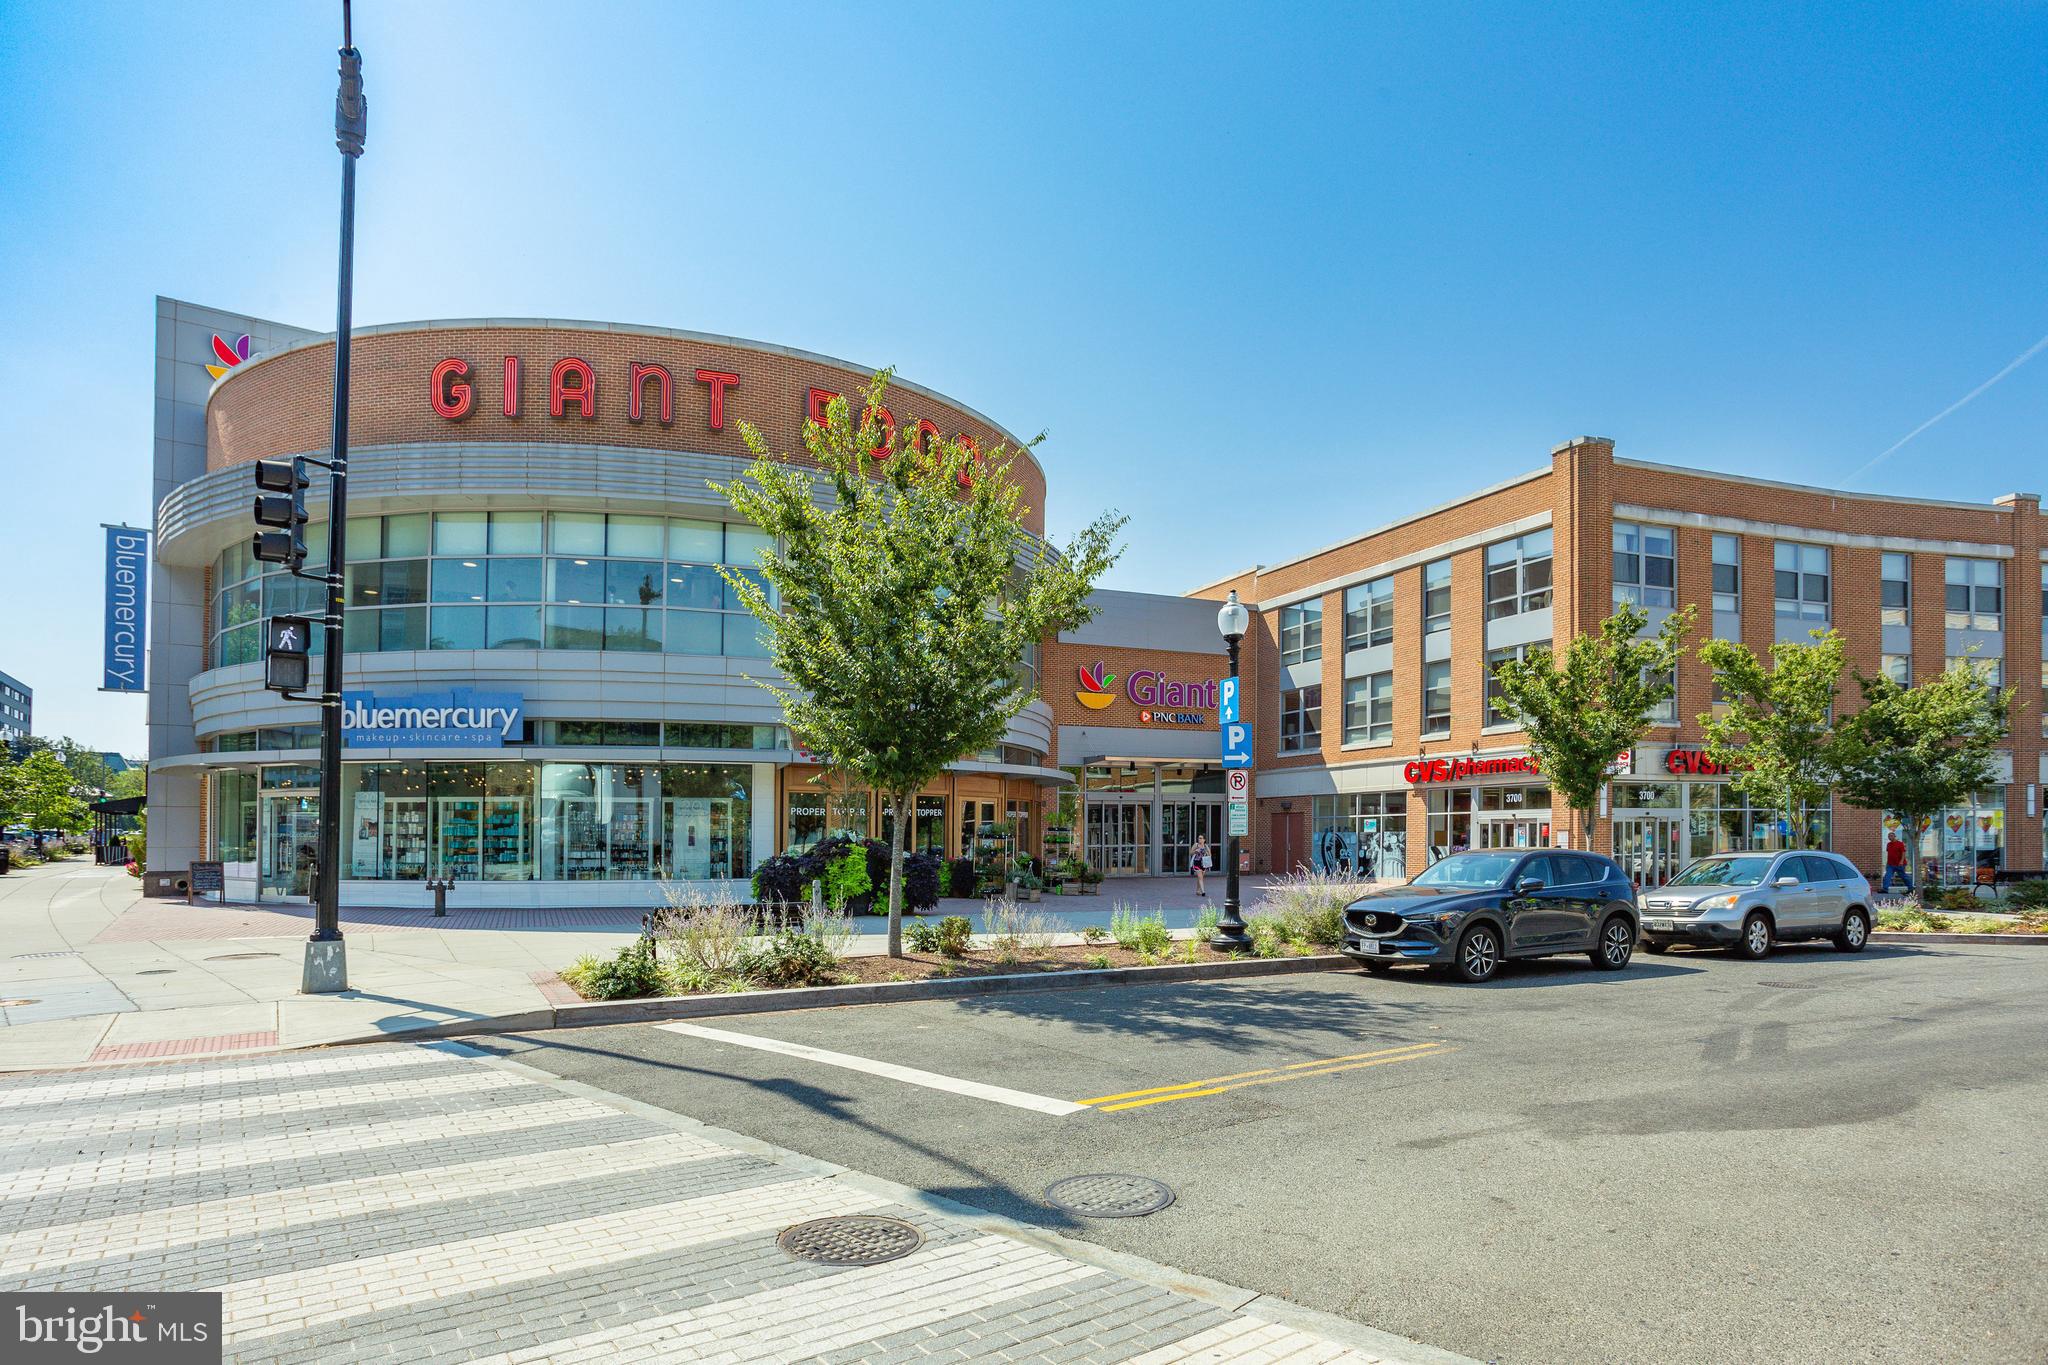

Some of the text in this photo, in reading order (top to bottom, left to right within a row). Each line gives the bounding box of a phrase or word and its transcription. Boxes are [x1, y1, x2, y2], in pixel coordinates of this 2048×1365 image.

[107, 535, 145, 684] bluemercury
[1128, 669, 1219, 709] Giant
[1223, 680, 1235, 706] P
[341, 700, 519, 736] bluemercury
[356, 731, 493, 744] makeup skincare spa
[1228, 725, 1245, 750] P
[1506, 793, 1523, 803] 3700
[1638, 791, 1655, 801] 3700
[790, 807, 826, 817] PROPER
[917, 808, 943, 817] TOPPER
